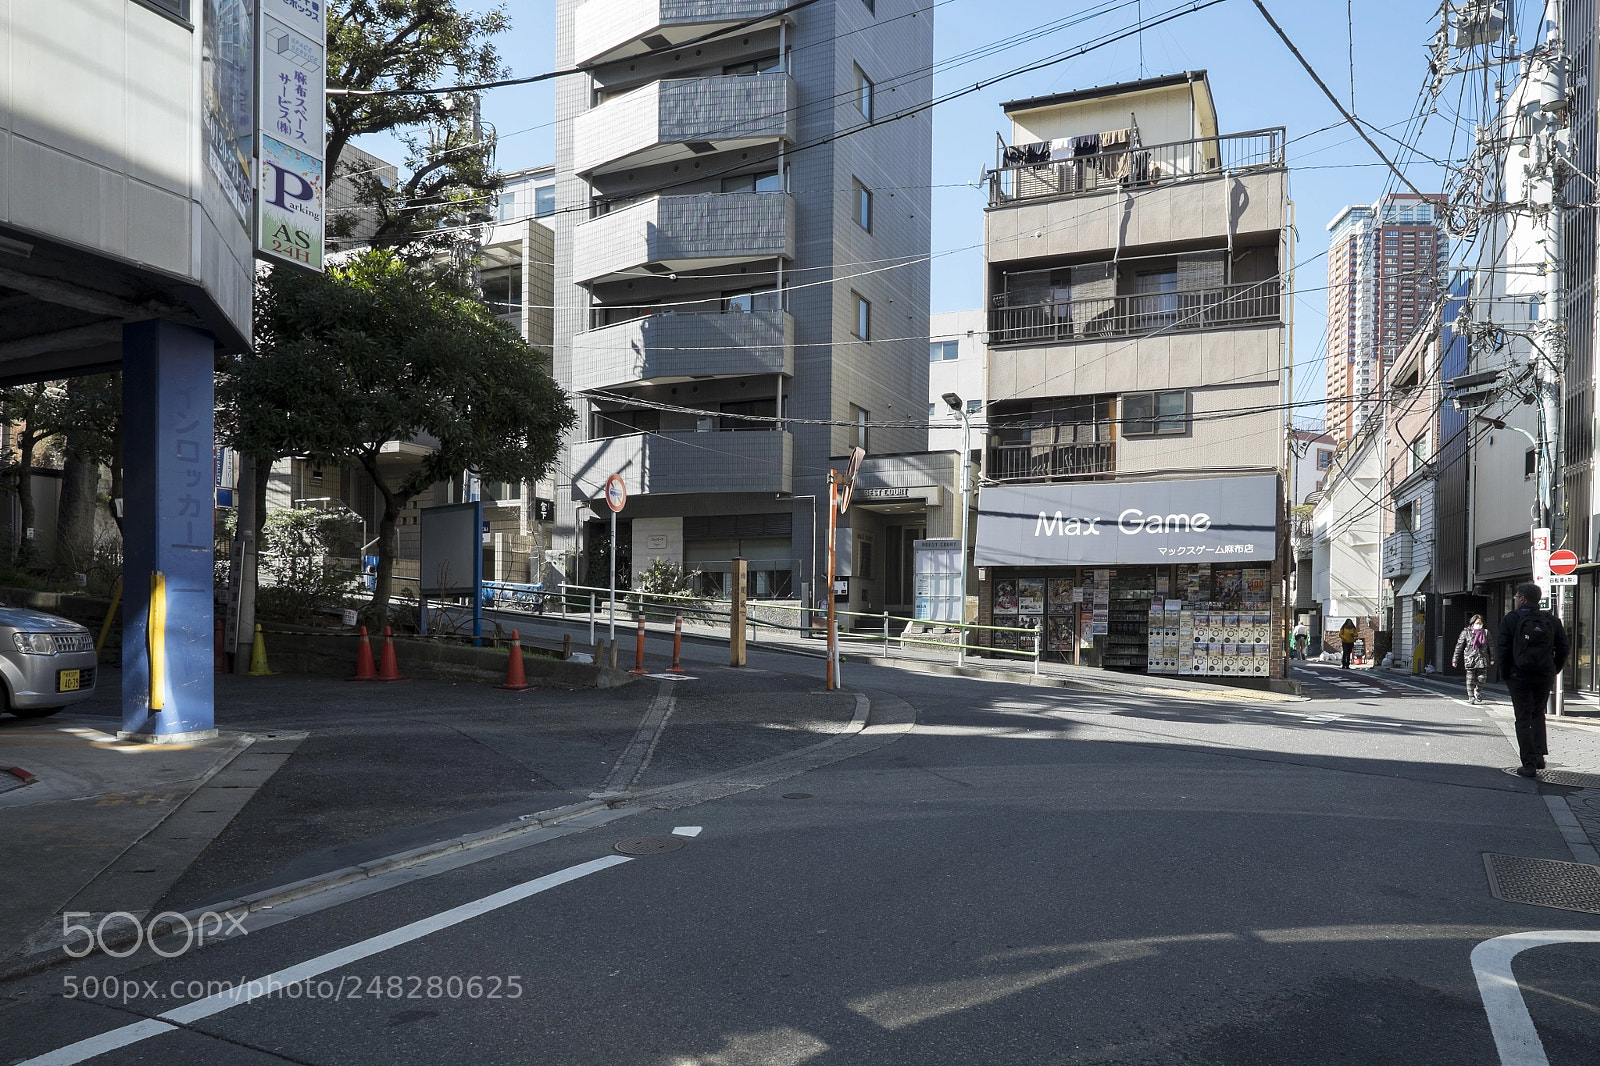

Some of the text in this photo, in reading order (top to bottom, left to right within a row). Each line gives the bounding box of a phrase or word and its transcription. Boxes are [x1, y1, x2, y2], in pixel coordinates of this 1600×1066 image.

[291, 37, 313, 53] SPACE
[291, 45, 318, 64] SERVICE
[294, 70, 307, 144] 麻布スペース
[272, 224, 310, 249] AS
[272, 240, 310, 263] 24H
[1034, 508, 1212, 537] Max Game
[1158, 543, 1254, 556] マックスゲーム麻布店
